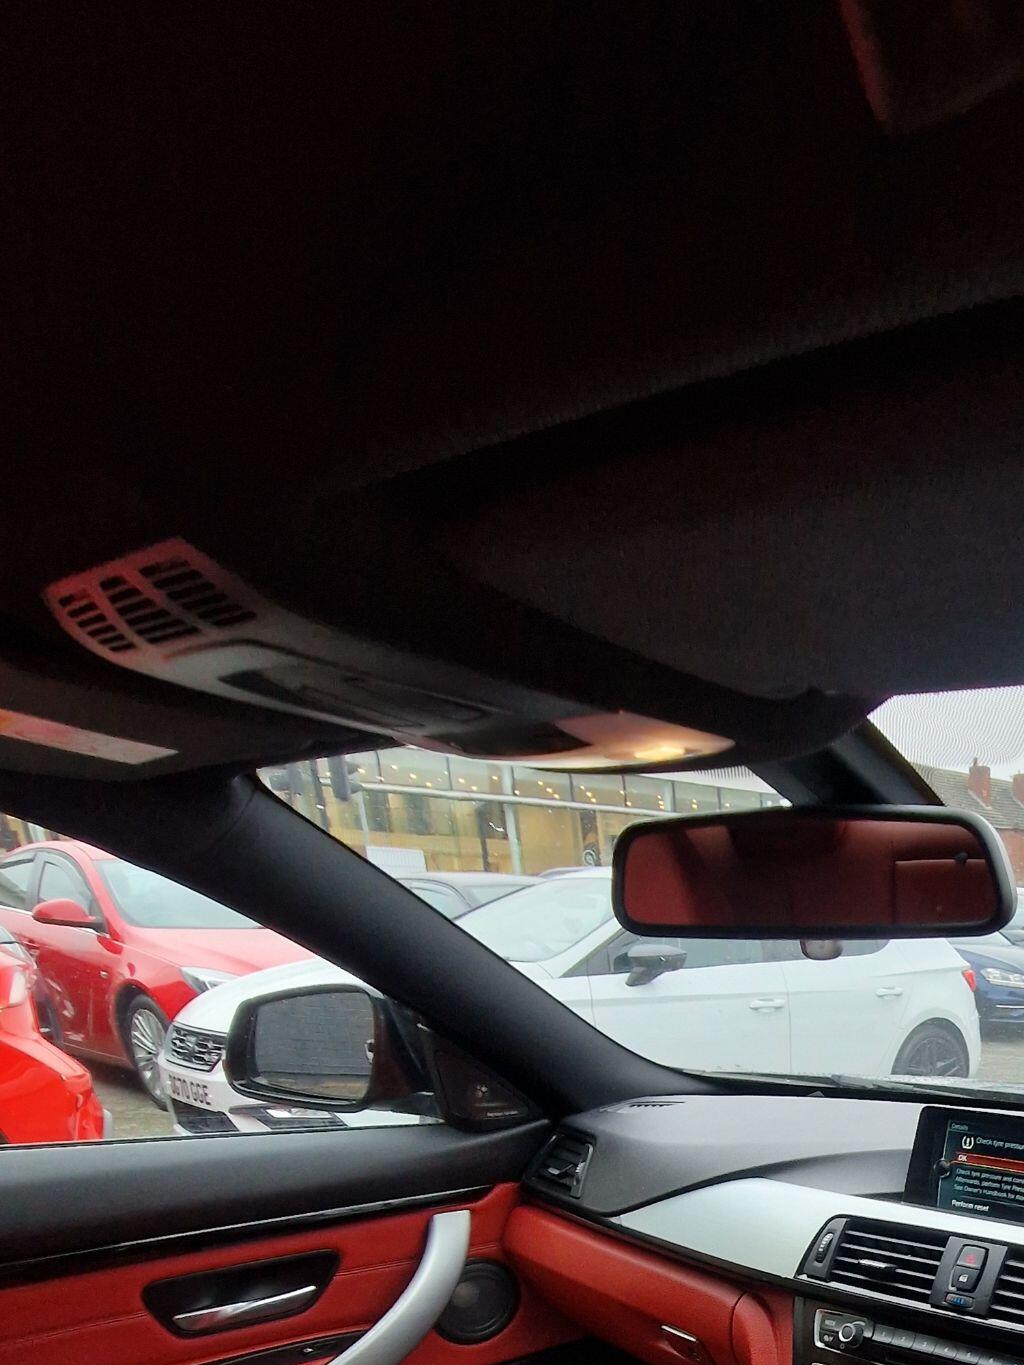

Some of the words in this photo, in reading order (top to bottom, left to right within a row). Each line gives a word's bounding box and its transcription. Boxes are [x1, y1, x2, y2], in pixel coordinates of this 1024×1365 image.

[976, 1136, 993, 1146] Check
[993, 1140, 1004, 1148] tyre
[958, 1154, 968, 1162] OK
[951, 1199, 974, 1210] Perform
